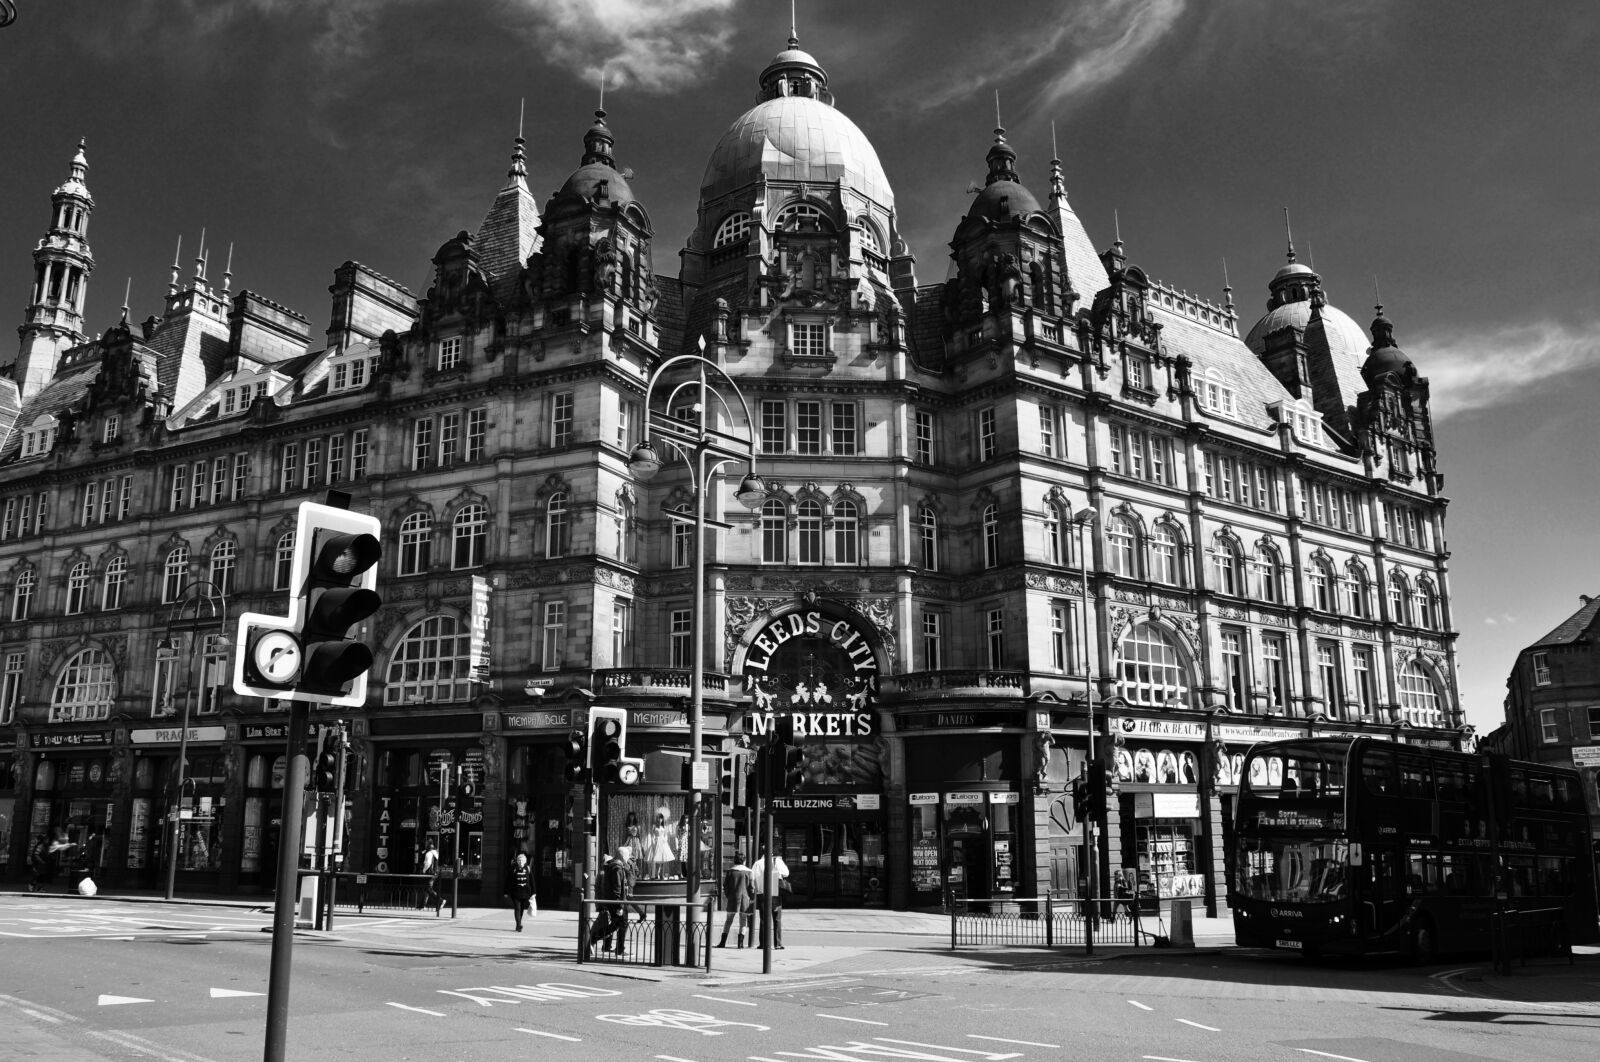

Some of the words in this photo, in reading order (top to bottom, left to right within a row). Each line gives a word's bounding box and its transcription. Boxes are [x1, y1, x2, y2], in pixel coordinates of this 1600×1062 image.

[746, 611, 821, 671] LEEDS
[831, 620, 877, 672] CITY
[544, 713, 568, 725] BELLE
[751, 712, 872, 736] MRKETS
[937, 713, 977, 727] DANIELS
[1139, 722, 1163, 733] HAIR
[1164, 724, 1170, 733] &
[1172, 724, 1205, 735] BEAUTY
[793, 799, 833, 808] BUZZING
[924, 849, 938, 857] OPEN
[1279, 909, 1304, 918] ARRIVA
